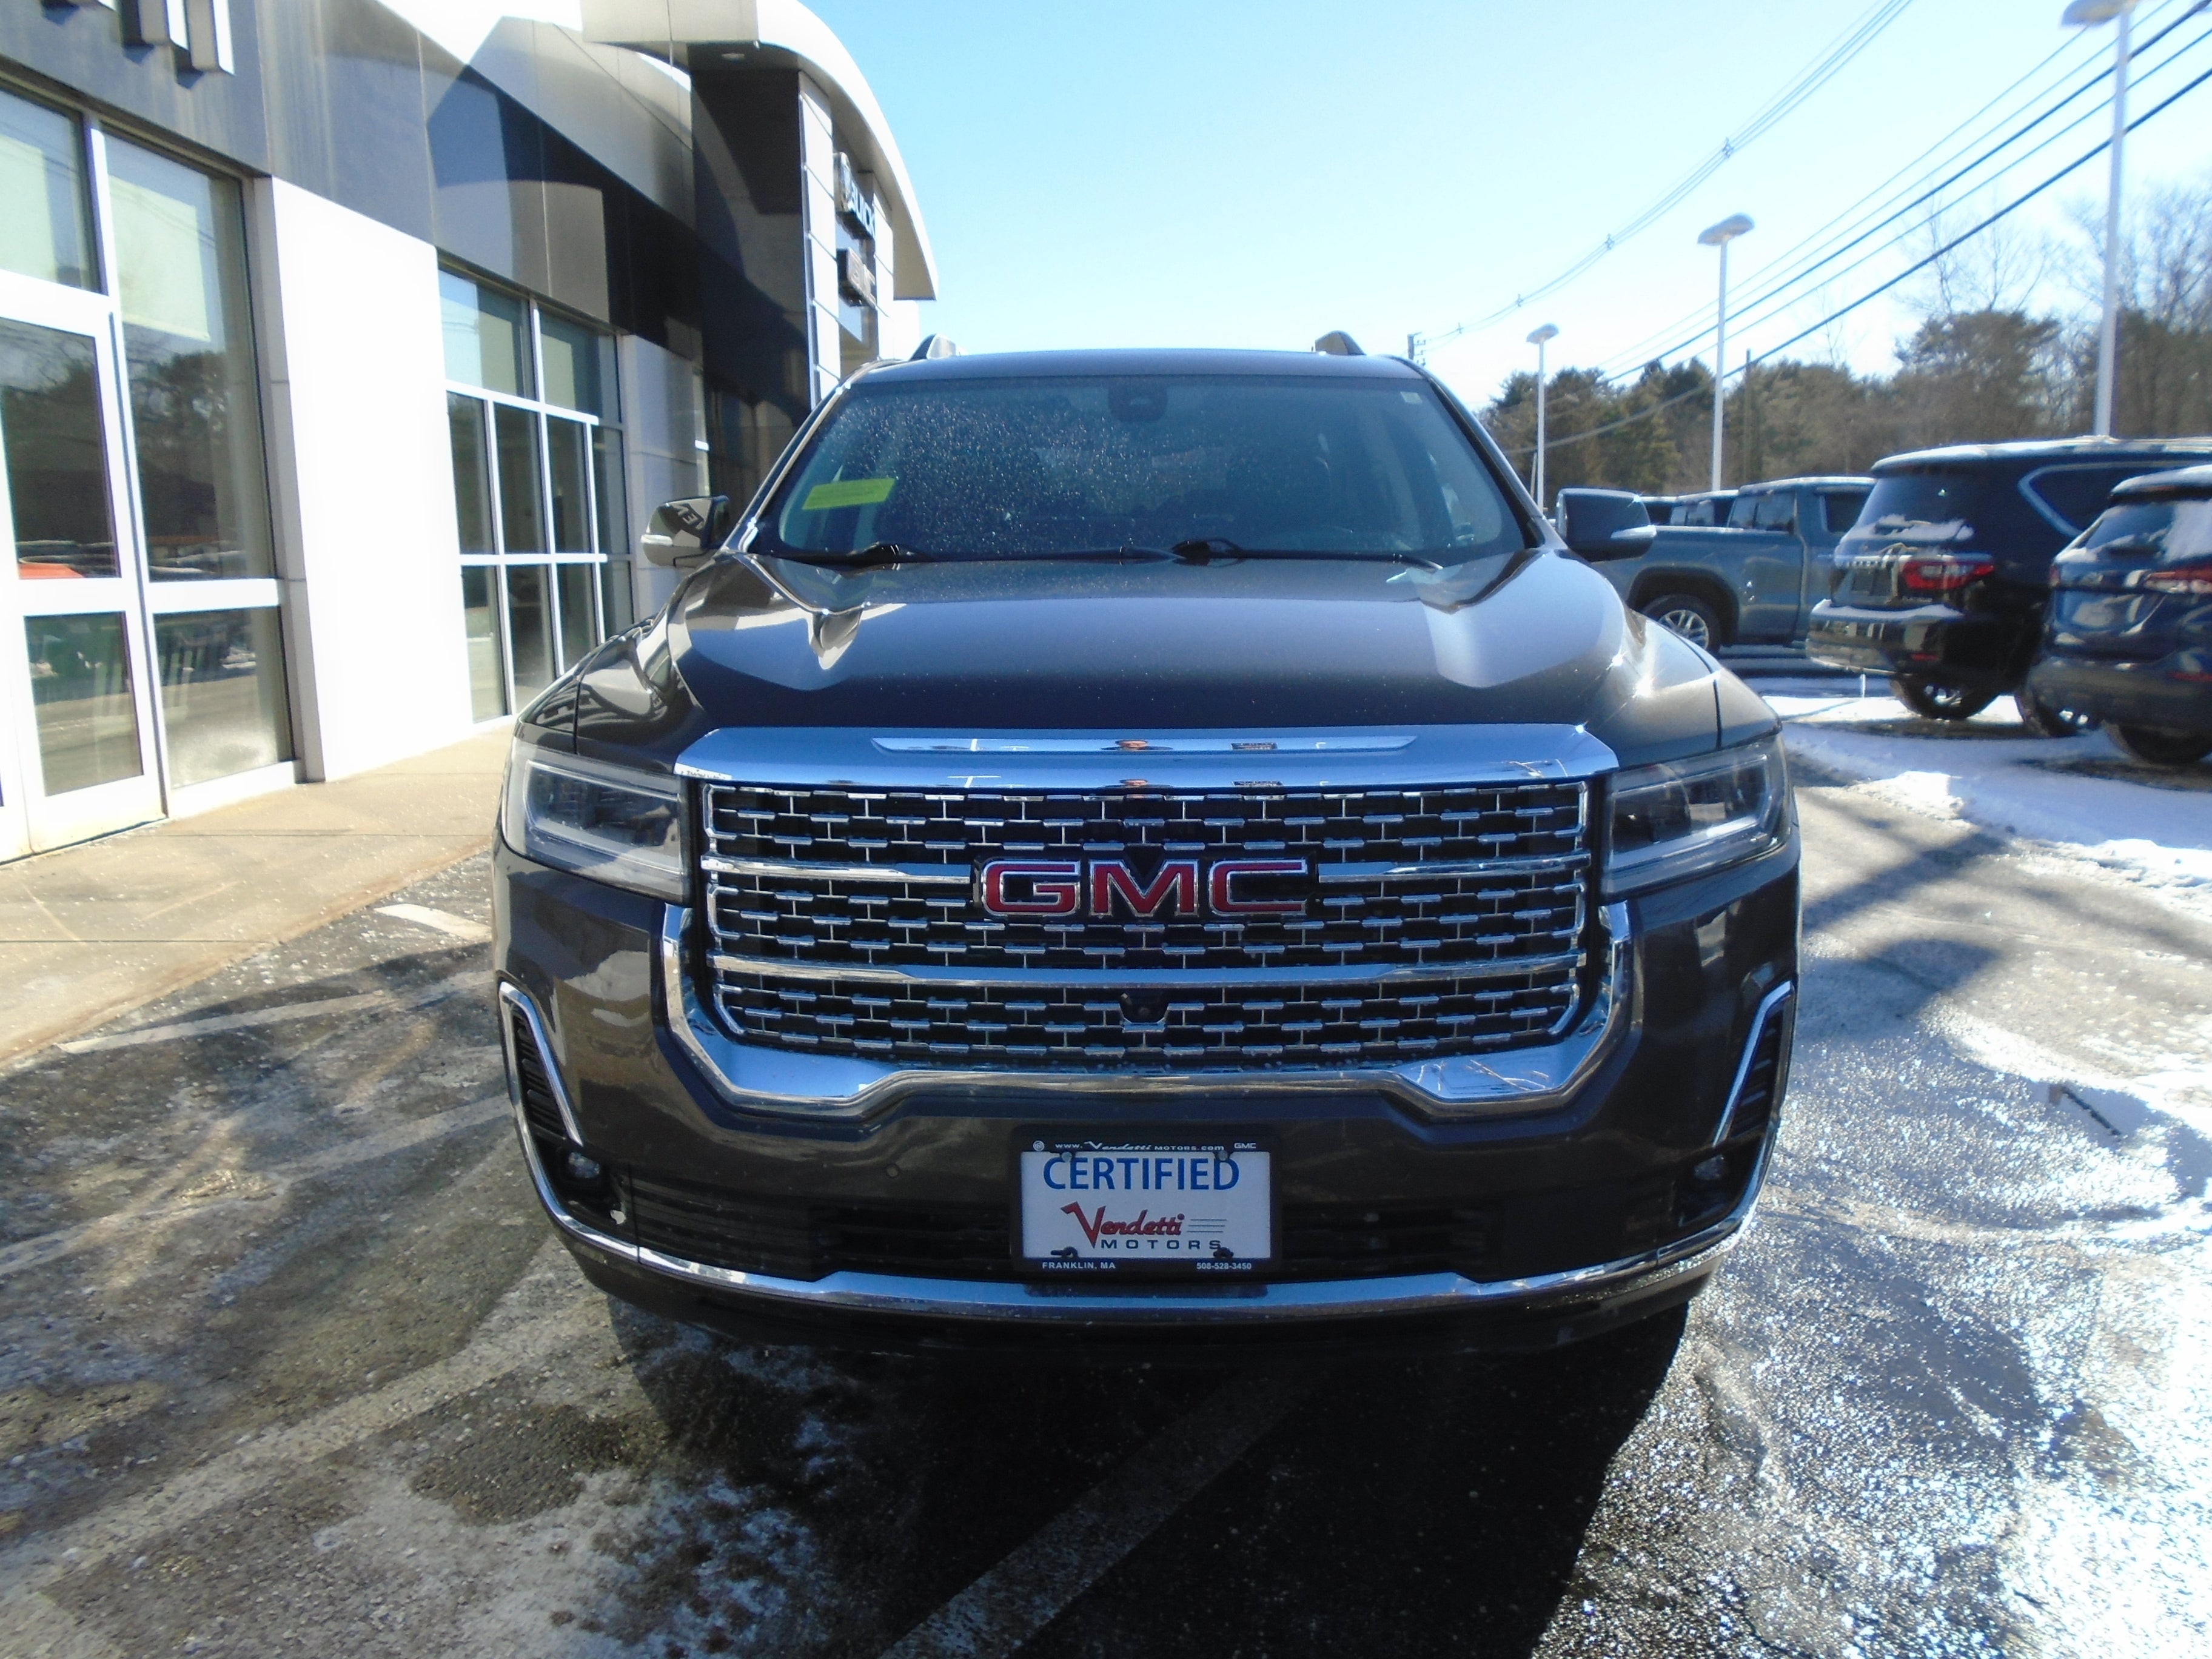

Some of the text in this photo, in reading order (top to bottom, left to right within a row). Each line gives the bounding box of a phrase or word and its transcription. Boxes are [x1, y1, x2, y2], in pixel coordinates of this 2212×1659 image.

[981, 858, 1308, 917] GMC
[1044, 1157, 1239, 1190] CERTIFIED
[1061, 1201, 1185, 1249] Vendetti
[1101, 1239, 1221, 1250] MOTORS
[1042, 1261, 1098, 1270] FRANKLIN,
